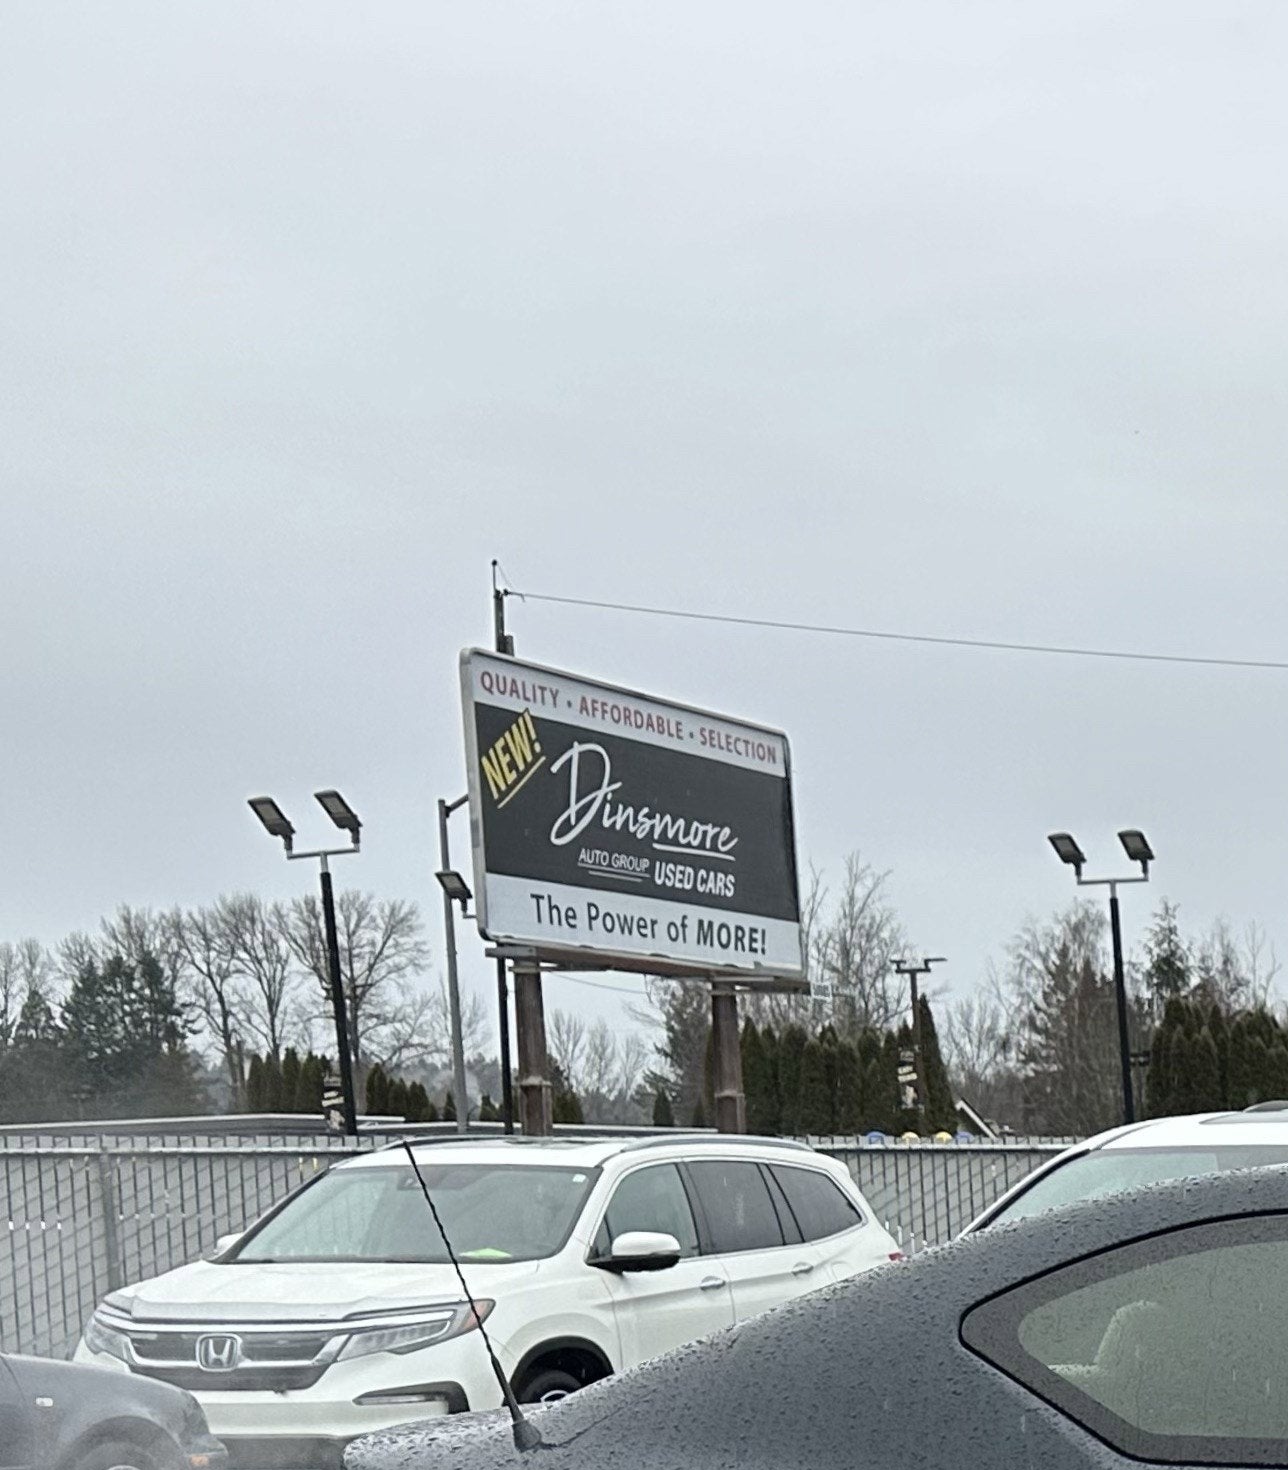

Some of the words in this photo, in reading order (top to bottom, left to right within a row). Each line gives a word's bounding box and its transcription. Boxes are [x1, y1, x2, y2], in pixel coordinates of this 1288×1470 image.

[481, 671, 559, 708] QUALITY
[578, 696, 684, 740] AFFORDABLE
[700, 727, 777, 764] SELECTION
[481, 710, 541, 800] NEW!
[550, 741, 738, 851] Dinsmore
[578, 848, 609, 867] AUTO
[612, 853, 650, 873] GROUP
[655, 861, 694, 890] USED
[697, 868, 735, 897] CARS
[530, 893, 577, 929] The
[587, 902, 658, 938] Power
[667, 914, 688, 943] of
[696, 919, 766, 954] MORE!
